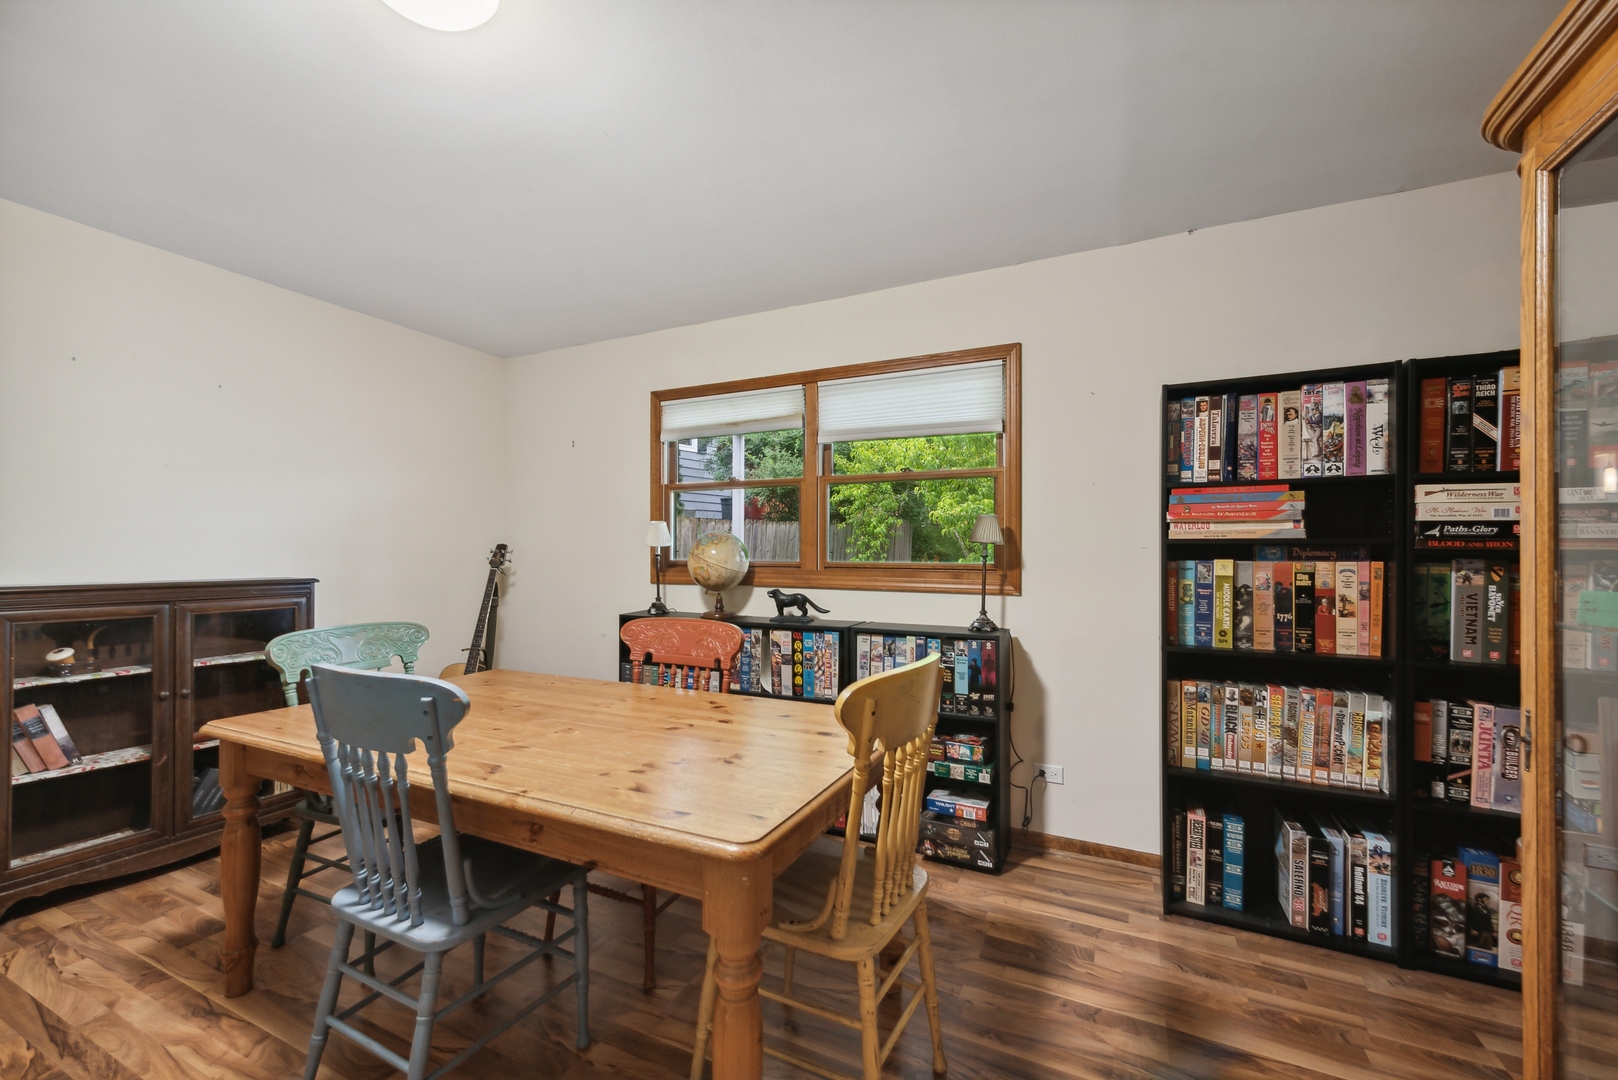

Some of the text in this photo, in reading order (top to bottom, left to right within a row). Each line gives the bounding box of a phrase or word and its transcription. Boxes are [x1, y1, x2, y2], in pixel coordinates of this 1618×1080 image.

[1211, 410, 1220, 445] Talavera
[1353, 408, 1364, 437] Napoleon
[1183, 420, 1194, 467] Marengo
[1352, 445, 1364, 469] Leipzig
[1173, 522, 1211, 530] WATERLOO
[1443, 525, 1499, 534] Paths Glory
[1292, 547, 1337, 560] Diplomacy
[1222, 583, 1231, 629] MIDDLE EARTH
[1276, 613, 1293, 622] 1776
[1487, 585, 1497, 623] BAYONET
[1495, 592, 1505, 614] SILVER
[1464, 593, 1479, 645] VIETNAM
[1186, 702, 1196, 745] Matanikau
[1201, 706, 1210, 727] GD
[1225, 704, 1238, 735] BLACK
[1254, 719, 1266, 731] GD
[1271, 694, 1282, 726] SEMPER
[1287, 701, 1297, 723] RAGING
[1241, 713, 1252, 750] LEROS
[1302, 720, 1315, 748] FROZEN
[1333, 713, 1346, 765] Stalingrad Pocket
[1351, 710, 1364, 749] CRUSADER
[1226, 734, 1234, 759] Wednesday
[1301, 749, 1313, 767] HELL
[1367, 723, 1382, 771] GAZALA
[1477, 722, 1492, 771] JUNTA
[1505, 751, 1519, 779] BUILDER
[1293, 859, 1306, 912] SALERNO '43
[1354, 866, 1365, 906] Holland '44
[1470, 865, 1497, 878] 1830
